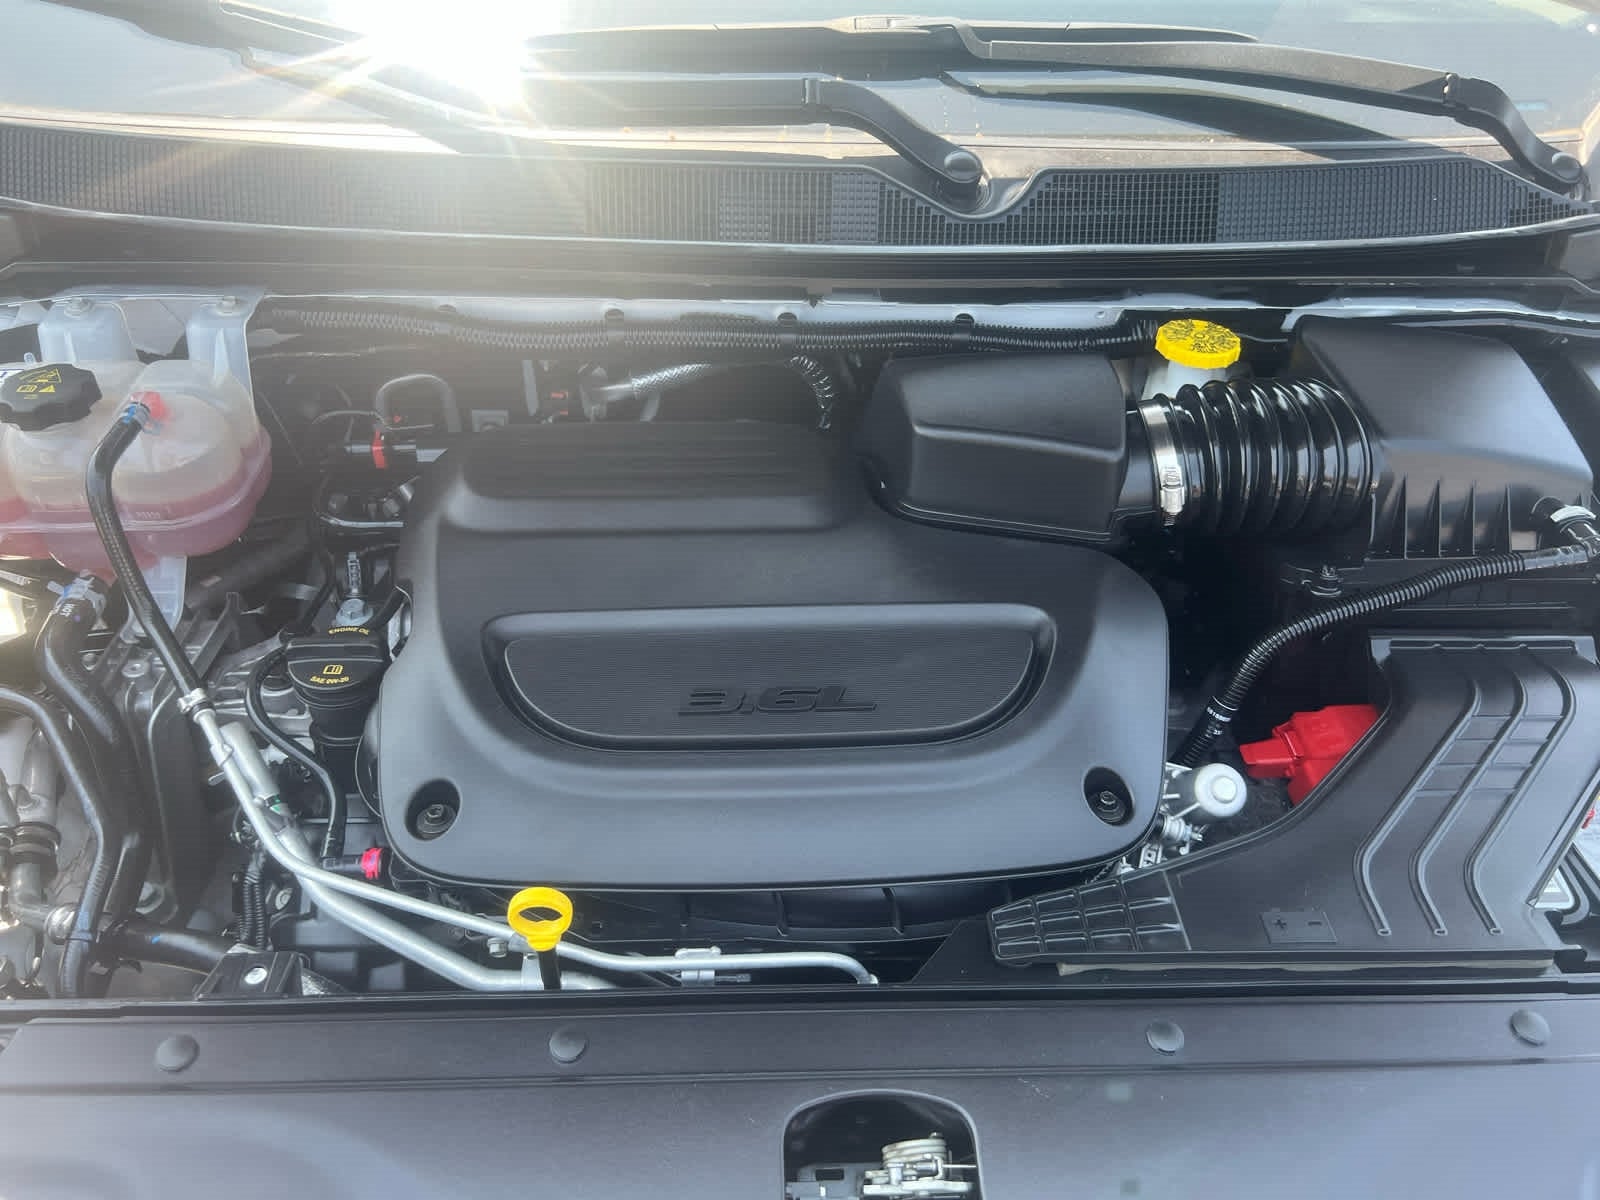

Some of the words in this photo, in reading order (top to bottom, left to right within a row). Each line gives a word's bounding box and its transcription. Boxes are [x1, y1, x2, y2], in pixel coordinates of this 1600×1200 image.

[328, 626, 359, 635] ENGINE
[310, 675, 327, 684] SAE
[678, 687, 878, 716] 3.6L
